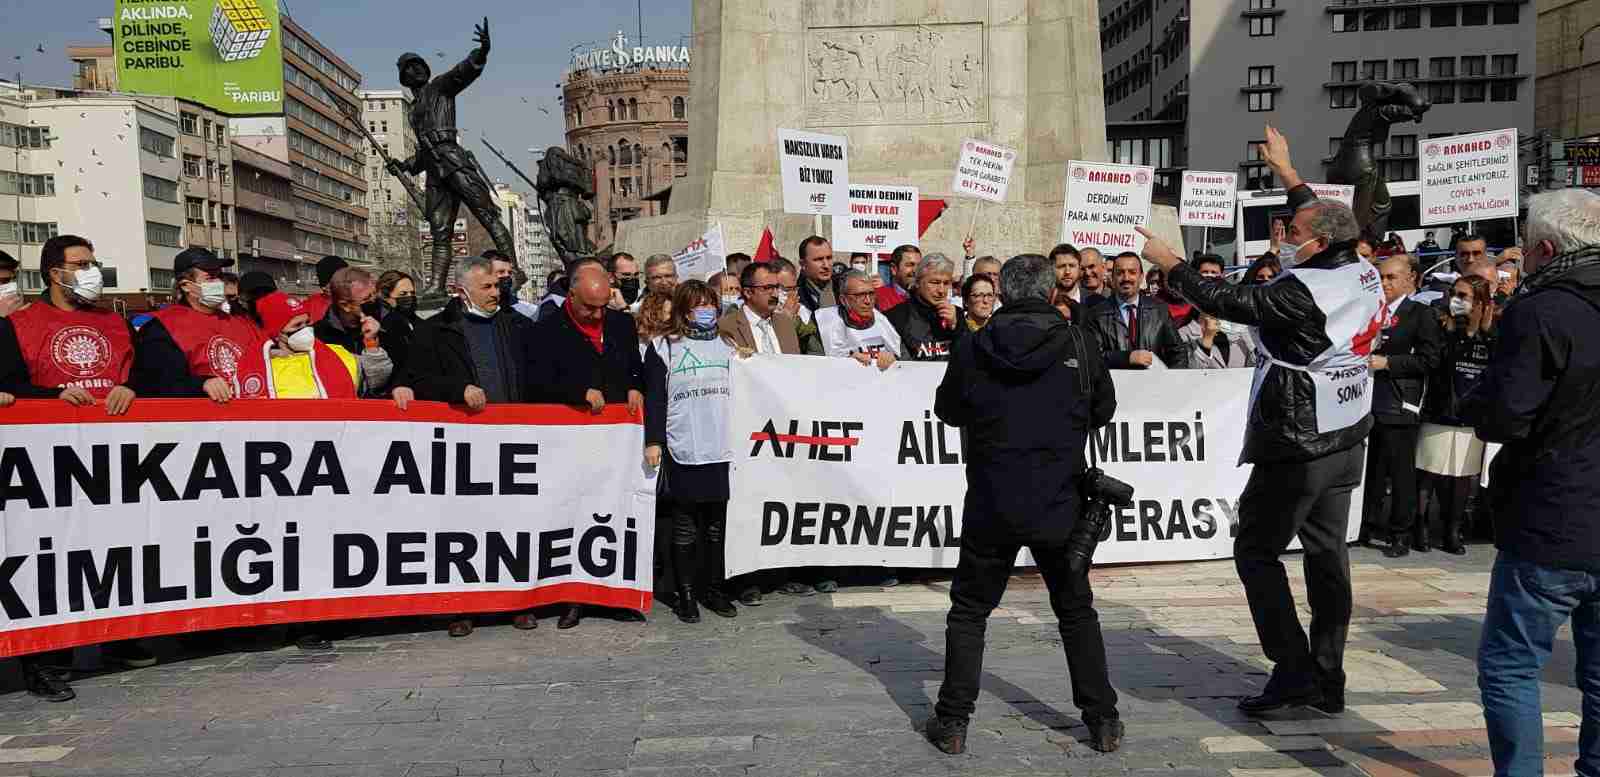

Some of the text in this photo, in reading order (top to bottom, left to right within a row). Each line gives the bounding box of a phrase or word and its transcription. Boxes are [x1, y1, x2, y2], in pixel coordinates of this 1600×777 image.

[121, 6, 193, 20] AKLINDA,
[121, 20, 186, 37] DİLİNDE,
[123, 36, 192, 53] CEBİNDE
[125, 53, 185, 70] PARİBU.
[820, 143, 843, 160] VARSA
[799, 165, 833, 184] BİZ YOKUZ
[1426, 174, 1466, 186] RAHMETLE
[1068, 210, 1088, 221] PARA
[1072, 230, 1136, 248] YANILDINIZ!
[750, 409, 1205, 465] AHEF AİL MLERİ
[0, 427, 539, 511] ANKARA AİLE
[761, 498, 1240, 548] DERNEKL ERASY
[333, 512, 638, 589] DERNEĞİ
